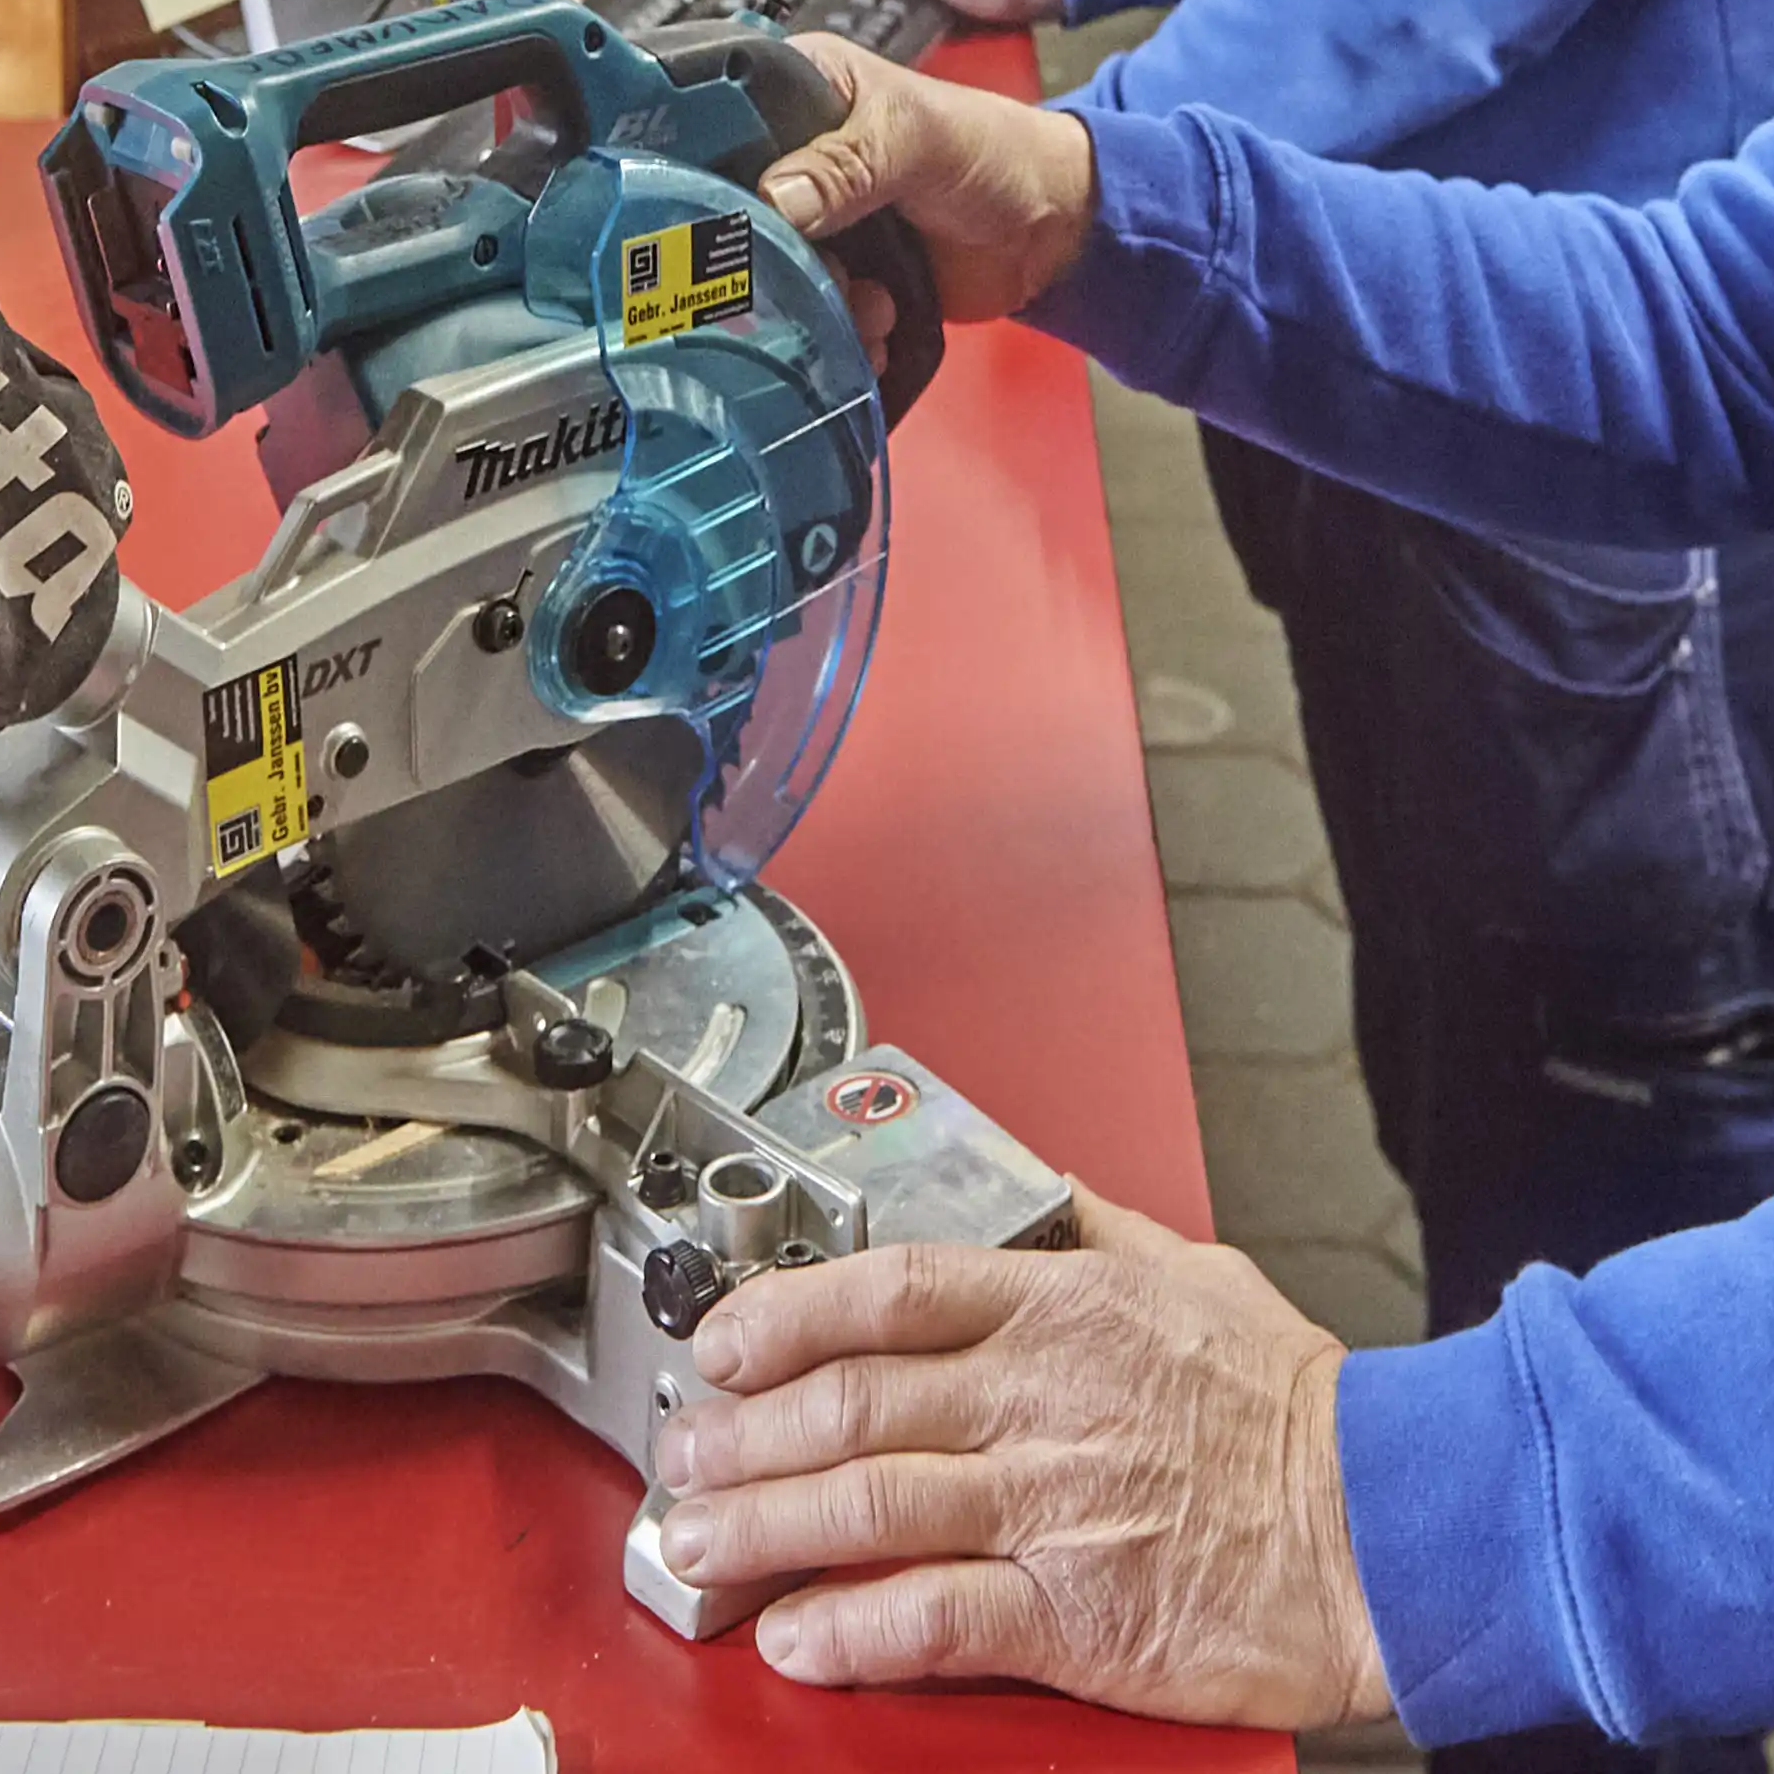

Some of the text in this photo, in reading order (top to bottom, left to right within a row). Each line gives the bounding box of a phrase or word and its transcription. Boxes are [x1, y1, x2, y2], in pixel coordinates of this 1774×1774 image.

[628, 275, 748, 327] Gebr. Janssen bv
[301, 638, 383, 700] DXT
[263, 671, 291, 844] Gebr. Janssen bv
